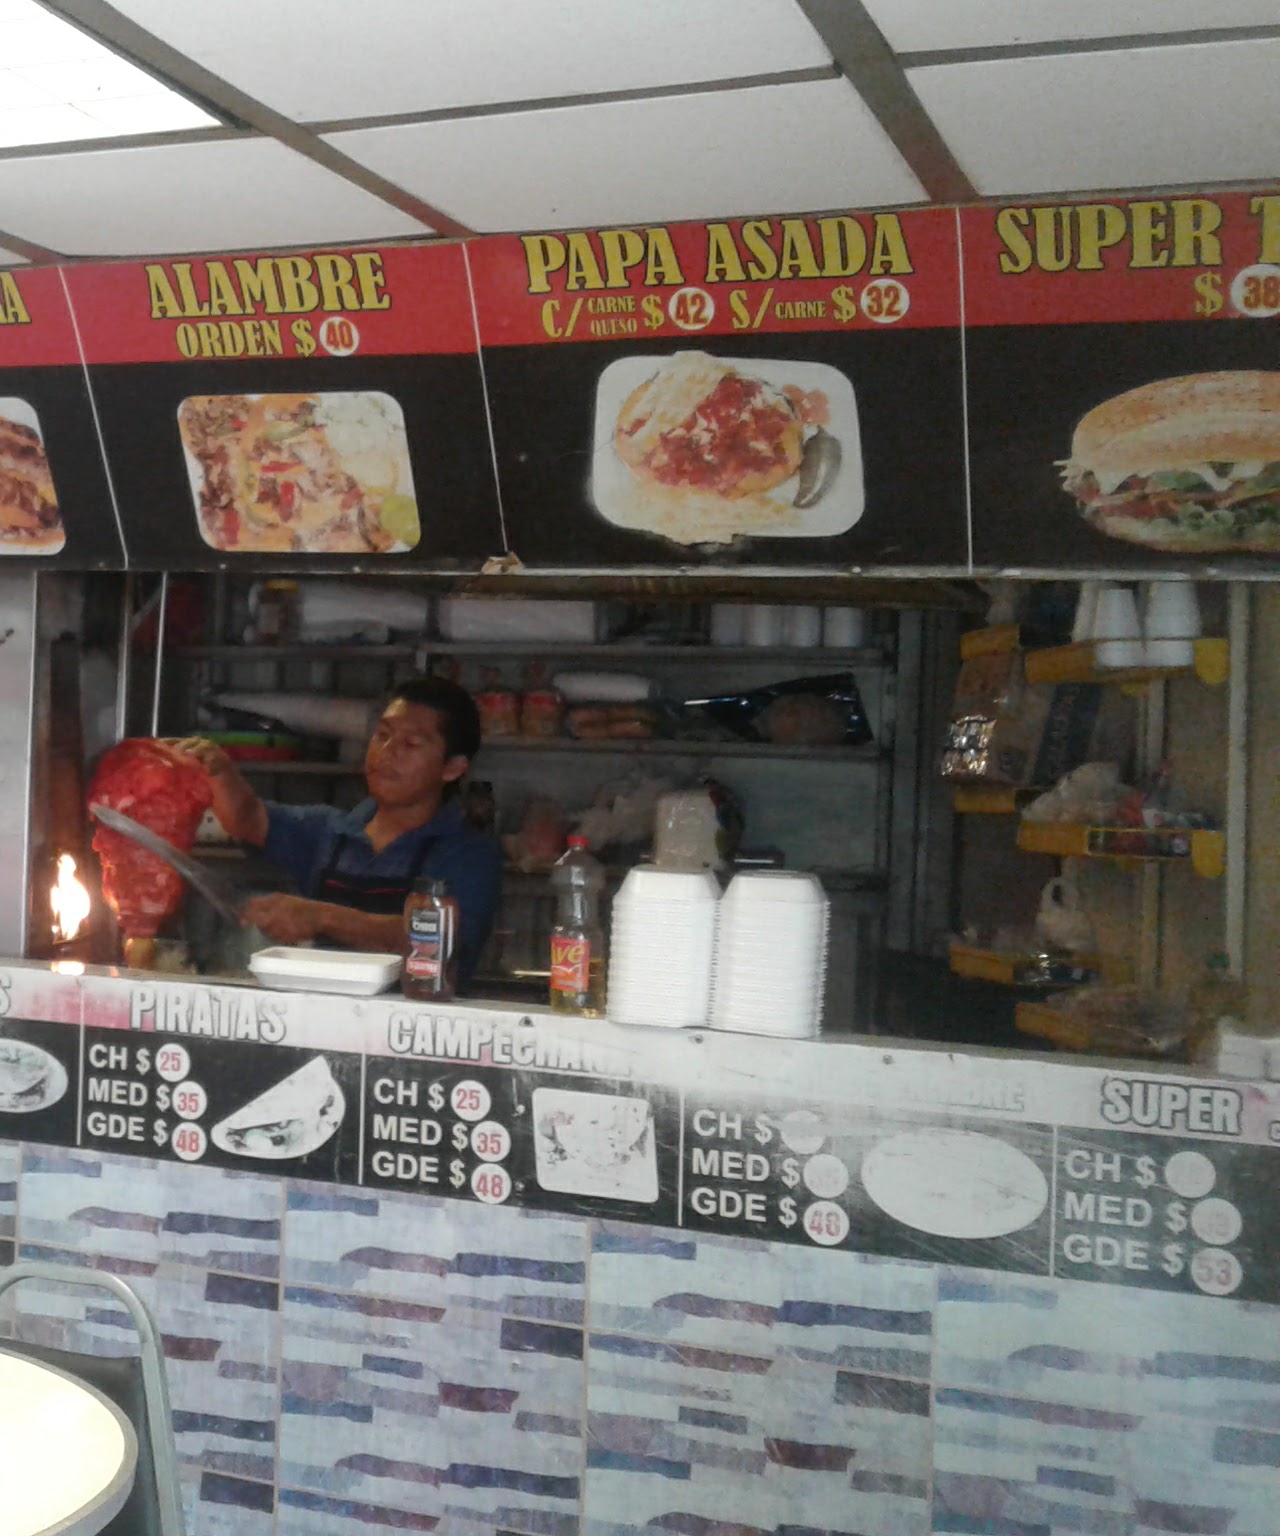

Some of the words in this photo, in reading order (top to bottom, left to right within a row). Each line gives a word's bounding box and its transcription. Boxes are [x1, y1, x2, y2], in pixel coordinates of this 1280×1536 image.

[519, 227, 686, 295] PAPA
[703, 211, 915, 285] ASADA
[996, 198, 1226, 275] SUPER
[144, 252, 393, 320] ALAMBRE
[587, 295, 637, 314] CARNE
[674, 292, 710, 326] 42
[774, 300, 828, 321] CARNE
[866, 284, 903, 317] 32
[174, 319, 284, 361] ORDEN
[324, 323, 355, 349] 40
[589, 317, 638, 337] QUESO
[129, 986, 287, 1043] PIRATAS
[88, 1044, 129, 1070] CH
[159, 1051, 182, 1072] 25
[387, 1011, 632, 1076] CAMPECHA
[88, 1078, 148, 1107] MED
[178, 1092, 200, 1113] 35
[373, 1079, 418, 1106] CH
[455, 1088, 481, 1110] 25
[1100, 1077, 1244, 1136] SUPER
[87, 1111, 145, 1142] GDE
[175, 1130, 201, 1153] 48
[372, 1113, 443, 1146] MED
[476, 1132, 502, 1156] 35
[692, 1108, 742, 1141] CH
[371, 1150, 440, 1183] GDE
[476, 1173, 505, 1198] 48
[691, 1147, 770, 1181] MED
[1063, 1148, 1121, 1182] CH
[690, 1186, 767, 1223] GDE
[1062, 1193, 1151, 1227] MED
[1062, 1235, 1150, 1271] GDE
